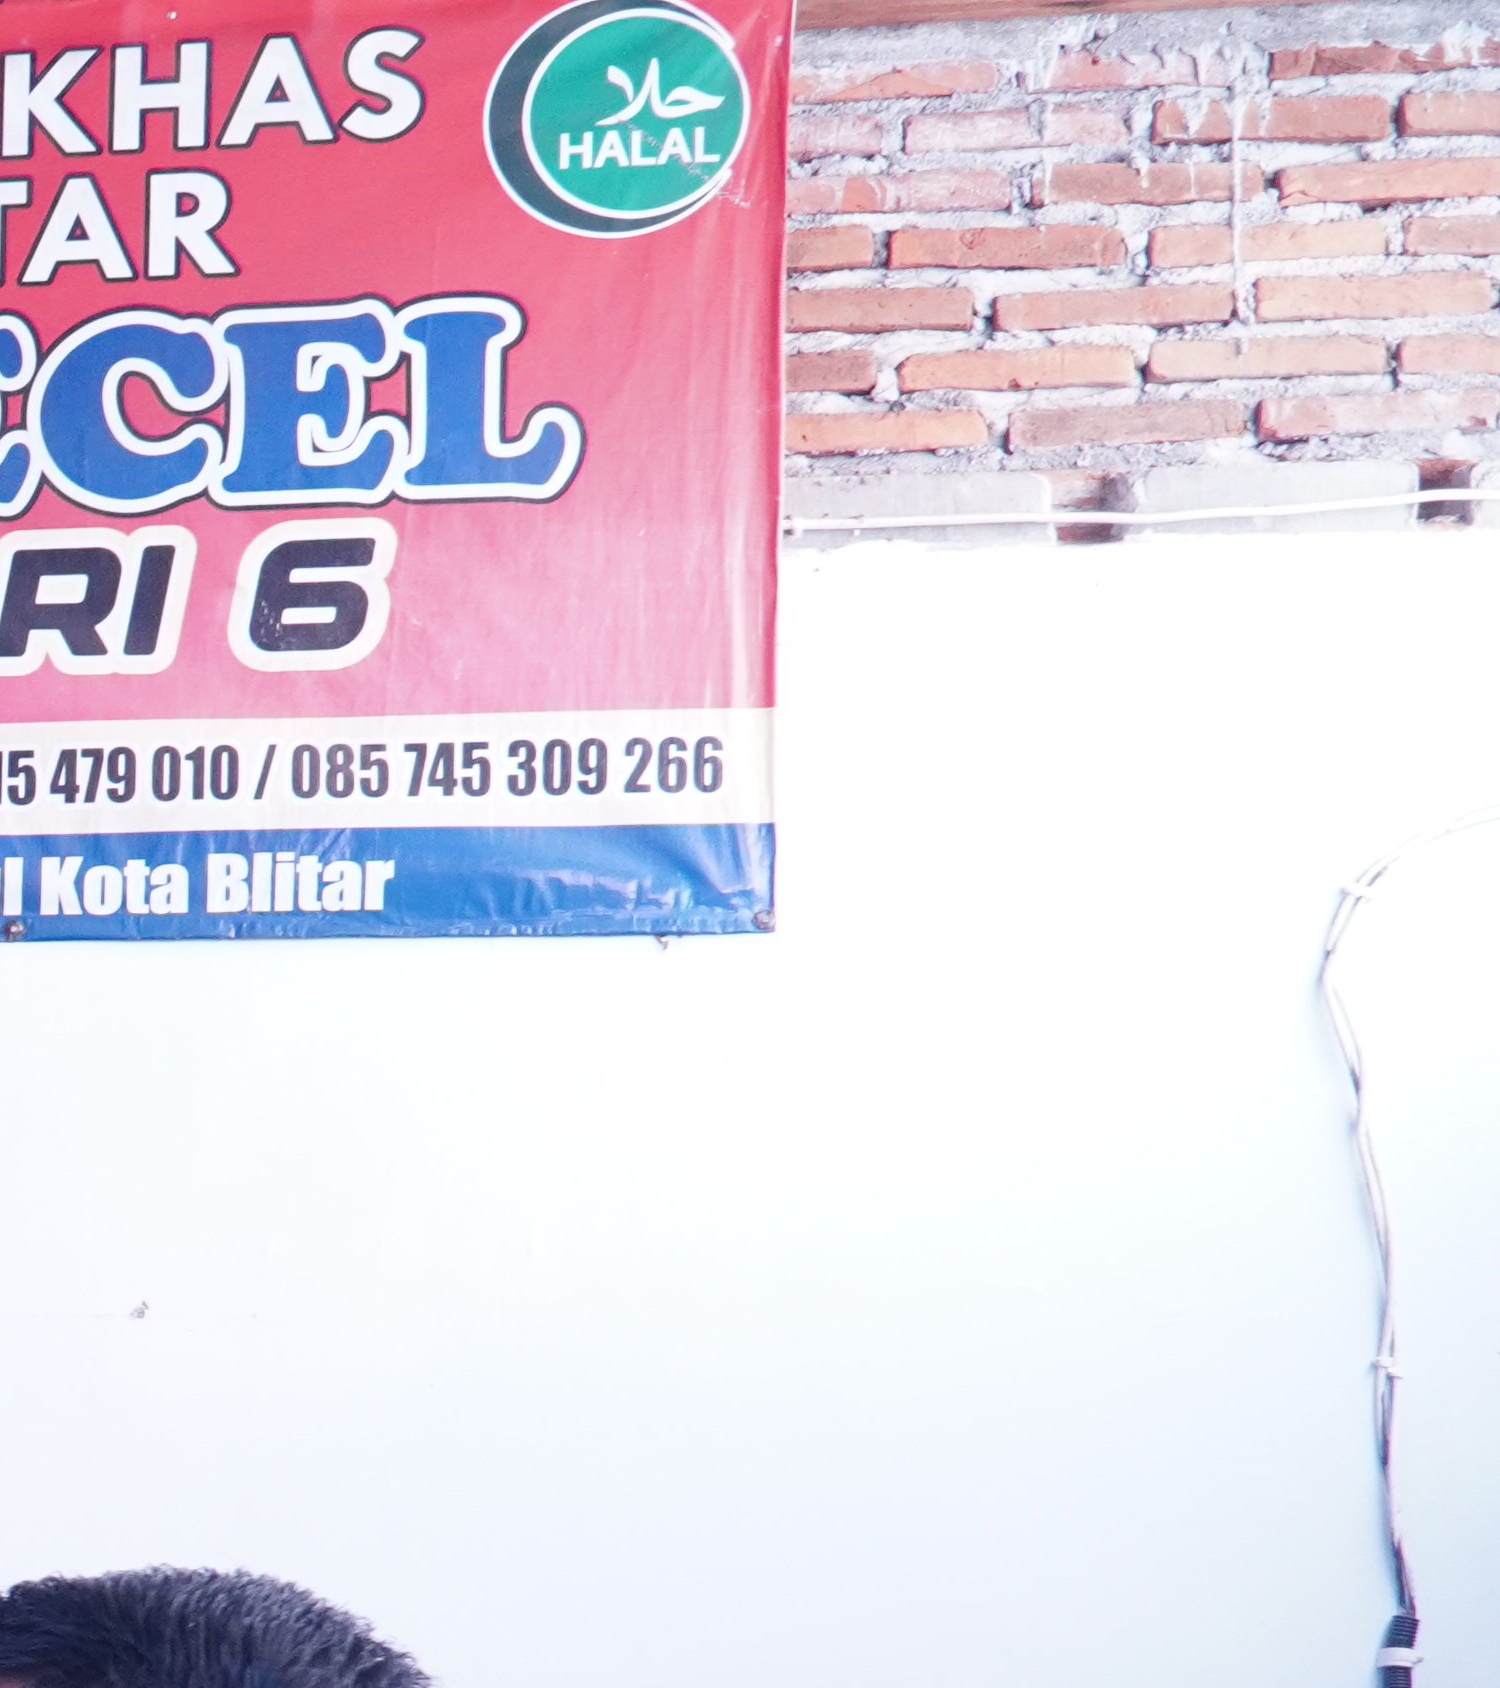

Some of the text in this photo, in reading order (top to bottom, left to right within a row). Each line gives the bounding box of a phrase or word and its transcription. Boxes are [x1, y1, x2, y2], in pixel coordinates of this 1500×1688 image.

[559, 126, 721, 170] HALAL
[245, 534, 379, 654] 6
[49, 748, 137, 804] 479
[151, 745, 241, 802] 010
[253, 743, 280, 803] /
[290, 743, 390, 800] 085
[403, 740, 491, 798] 745
[506, 738, 609, 797] 309
[623, 736, 725, 795] 266
[39, 856, 189, 917] Kota
[204, 852, 395, 915] Blitar
